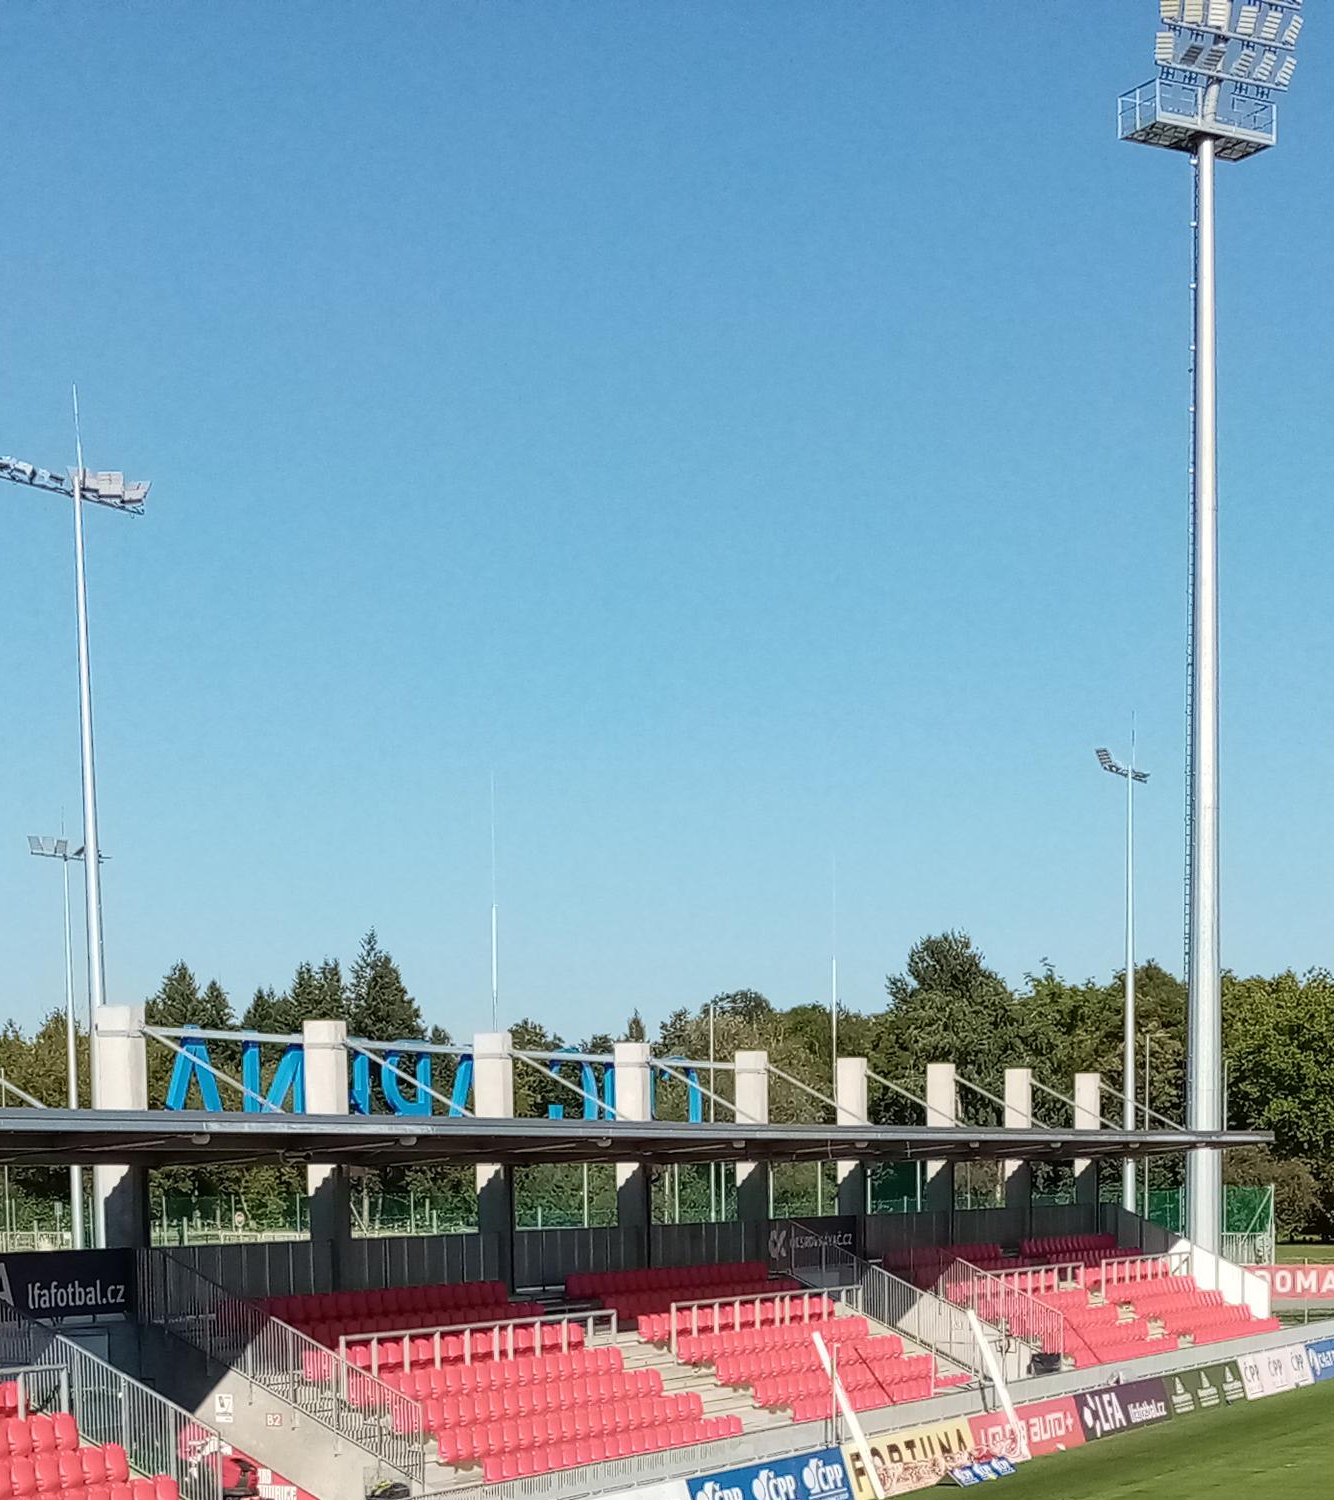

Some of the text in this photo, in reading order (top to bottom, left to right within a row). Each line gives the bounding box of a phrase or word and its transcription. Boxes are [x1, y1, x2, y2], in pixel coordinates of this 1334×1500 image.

[28, 1279, 125, 1310] lfafotbal.cz
[267, 1414, 281, 1426] B2
[817, 1459, 844, 1491] ČPP
